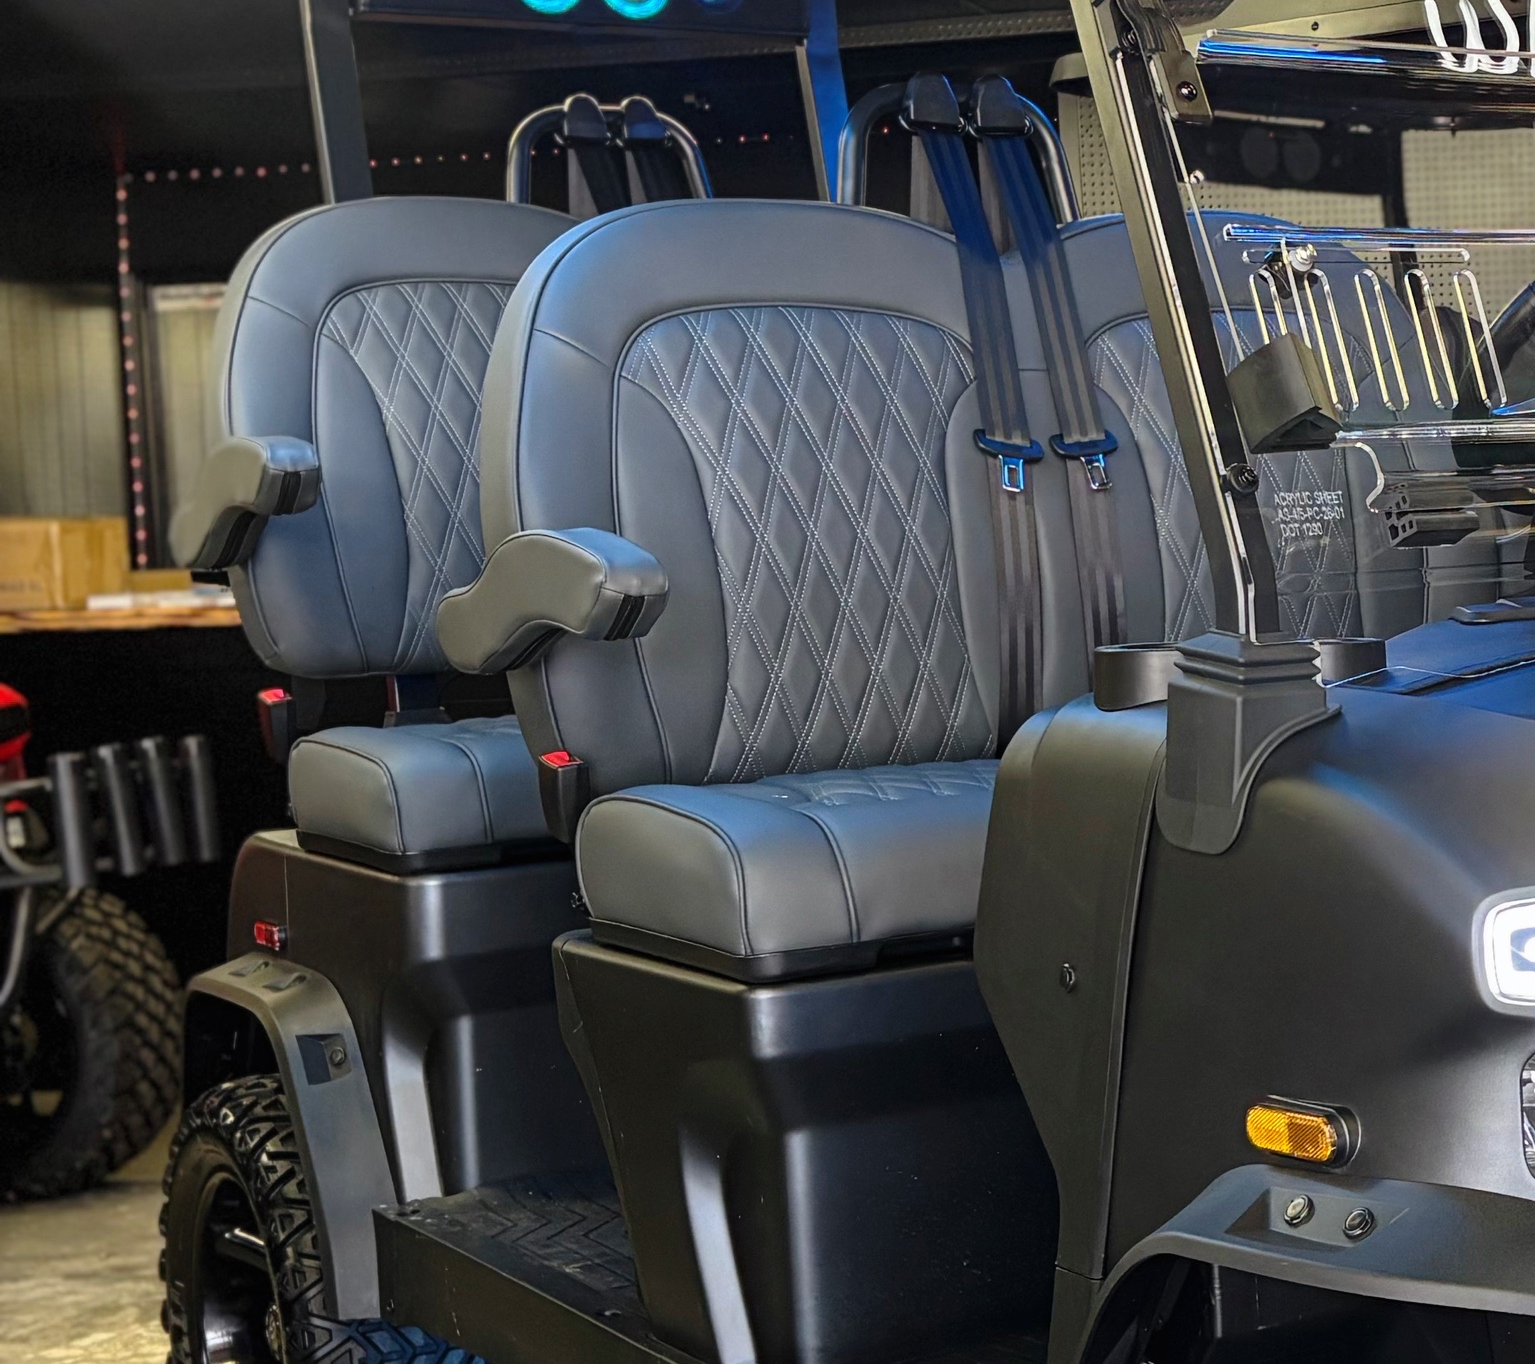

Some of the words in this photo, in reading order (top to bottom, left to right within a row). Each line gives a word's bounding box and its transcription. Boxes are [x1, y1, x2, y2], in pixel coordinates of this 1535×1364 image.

[1274, 491, 1313, 506] ACRYLIC
[1313, 490, 1344, 504] SHEET
[1280, 523, 1300, 537] DOT
